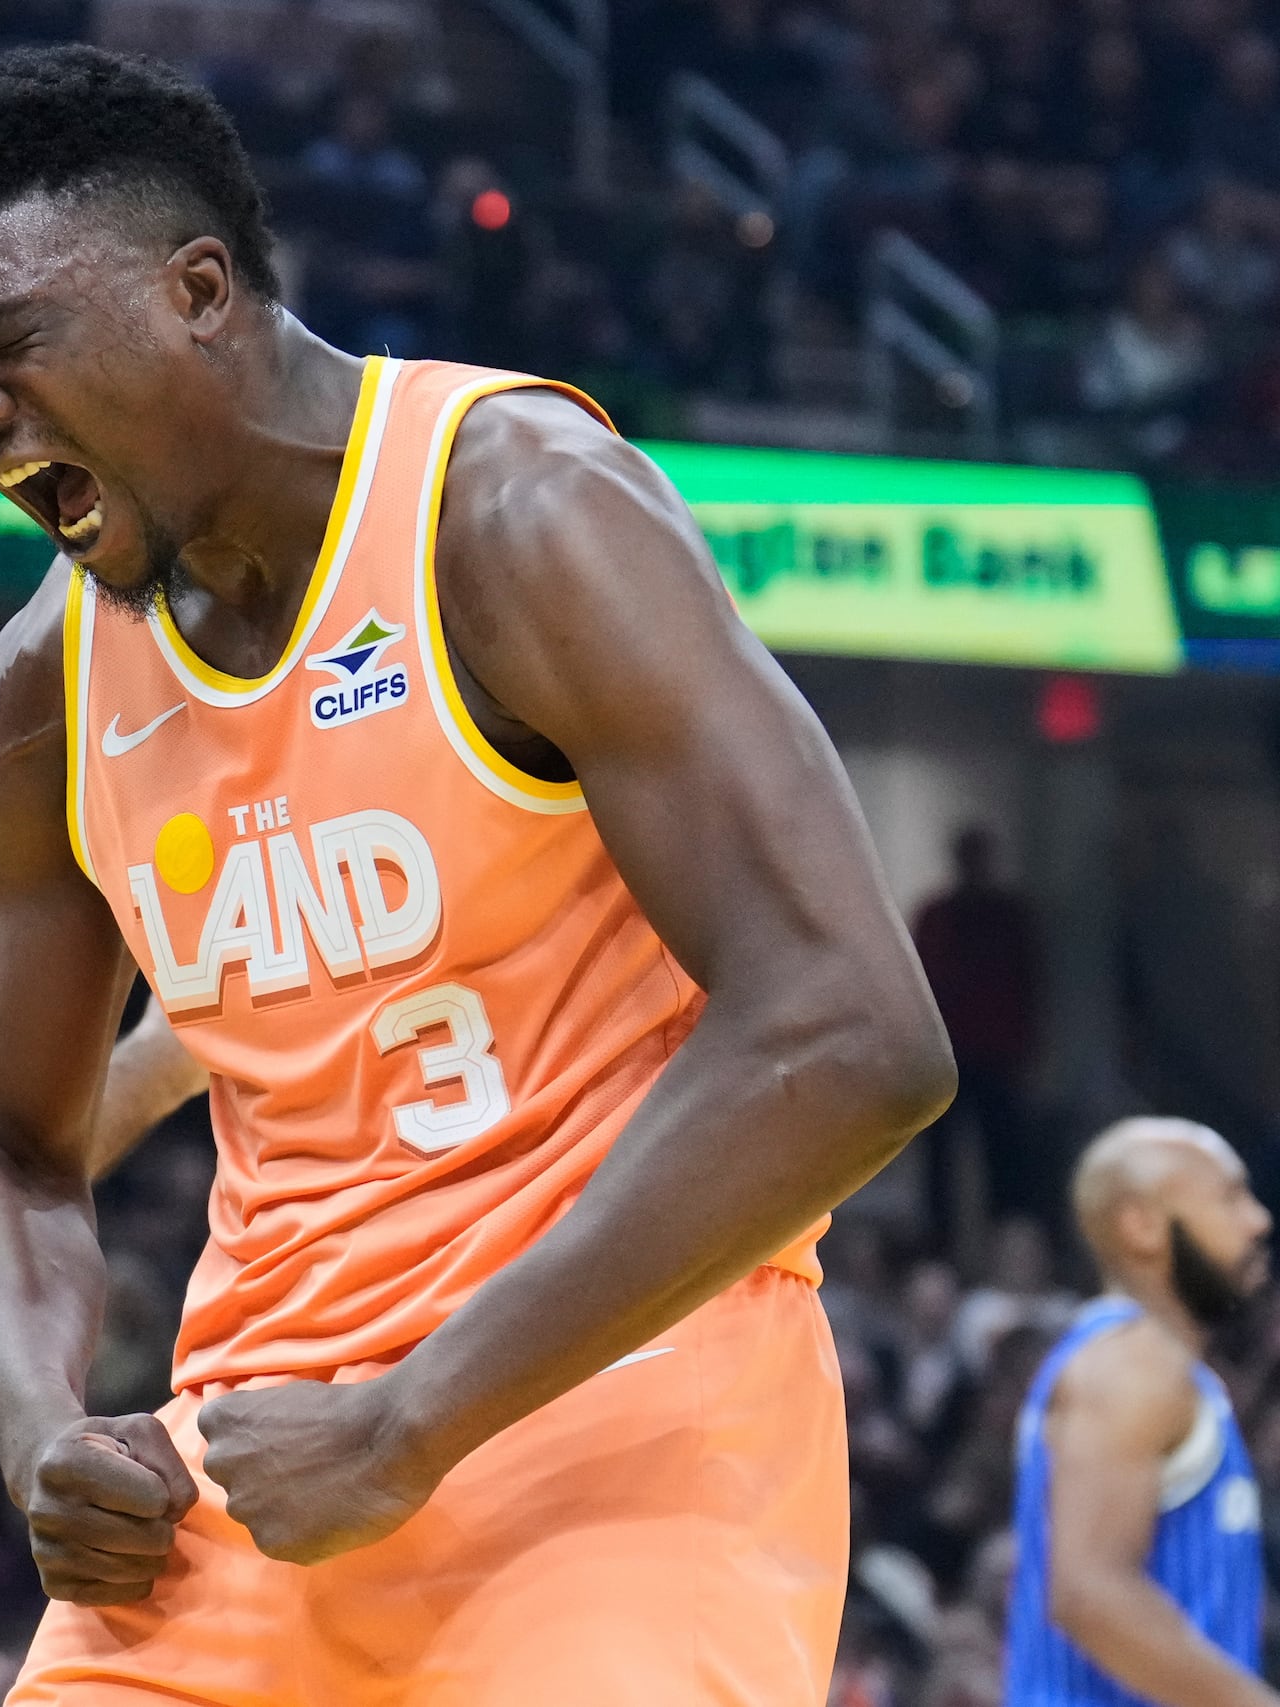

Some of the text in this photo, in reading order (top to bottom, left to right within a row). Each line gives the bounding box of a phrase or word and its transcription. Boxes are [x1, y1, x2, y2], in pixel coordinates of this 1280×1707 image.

[315, 672, 408, 721] CLIFFS
[228, 795, 291, 836] THE
[127, 808, 443, 1024] LAND
[369, 982, 513, 1160] 3
